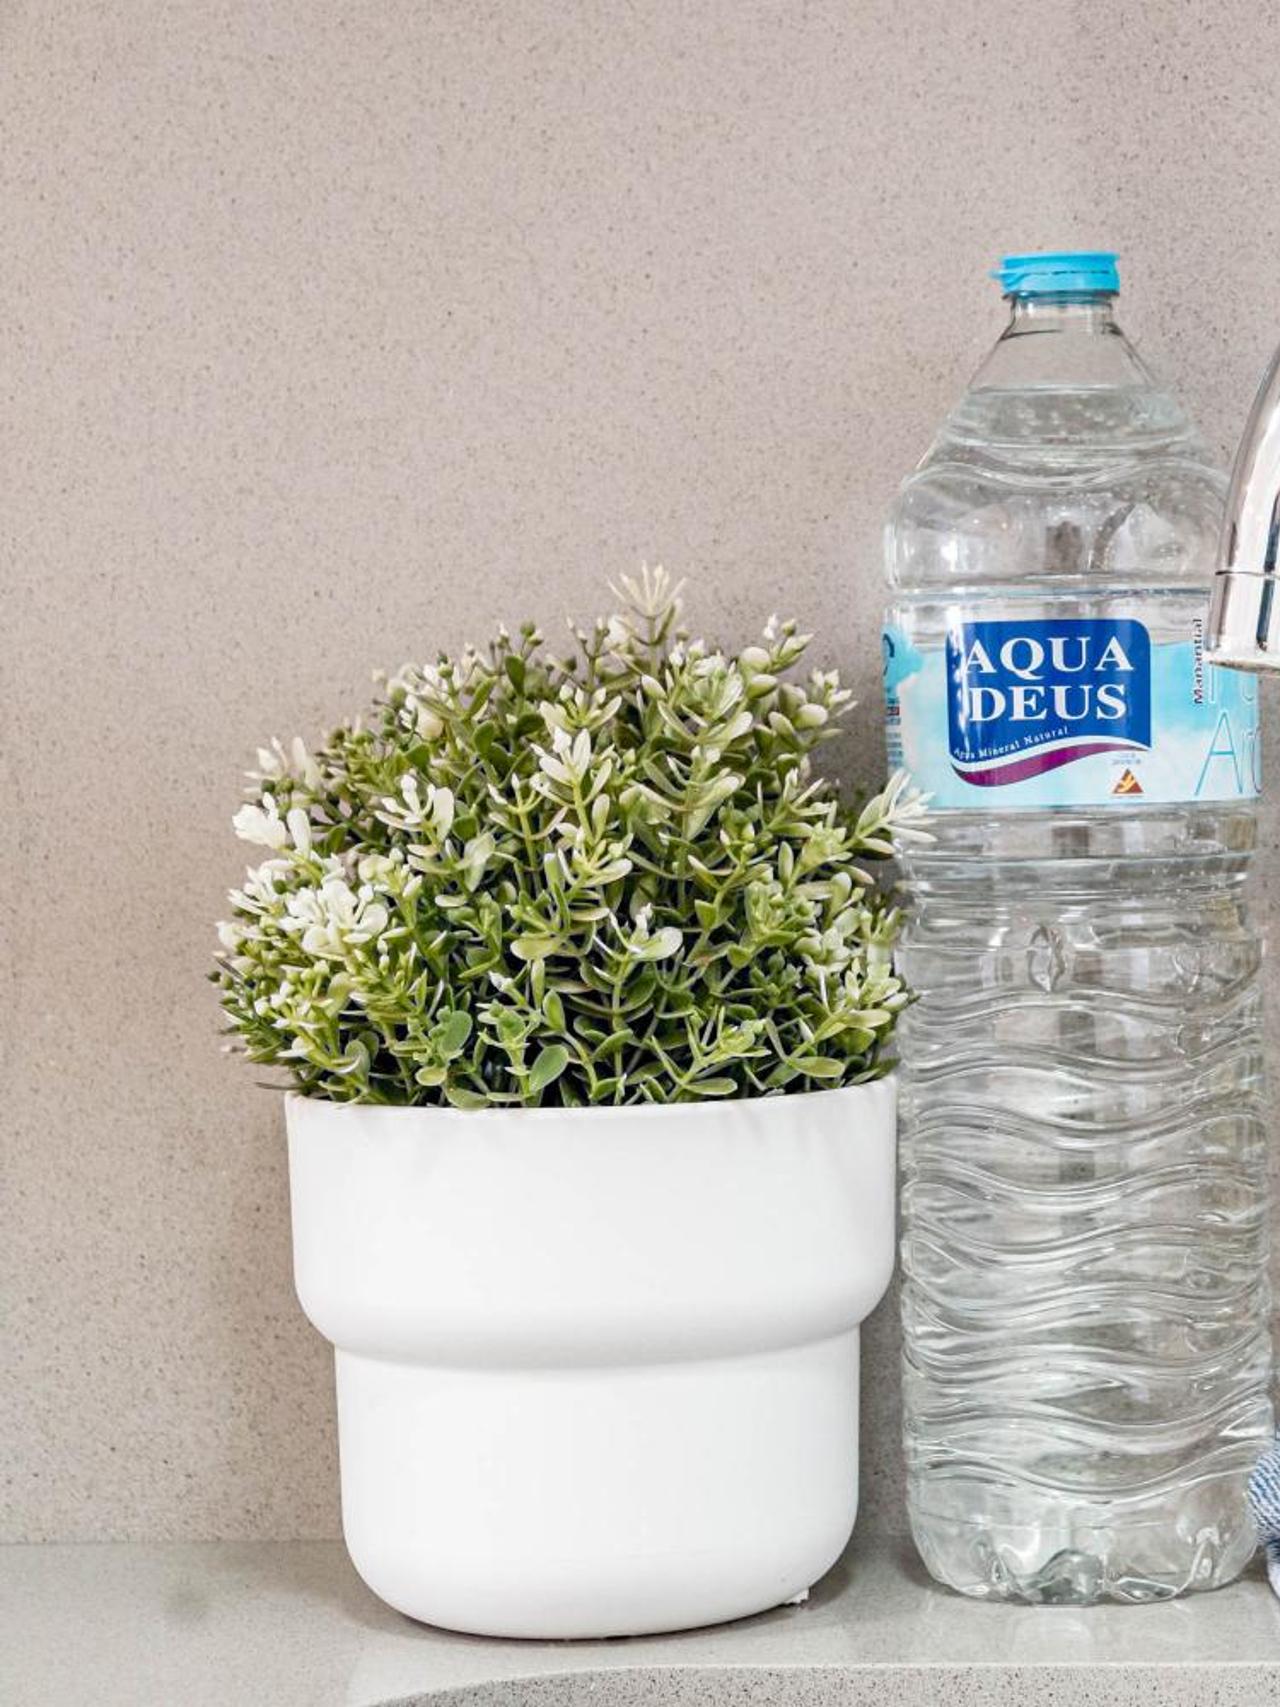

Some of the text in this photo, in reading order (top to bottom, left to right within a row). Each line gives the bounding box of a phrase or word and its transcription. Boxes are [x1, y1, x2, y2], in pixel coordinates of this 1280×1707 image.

[965, 636, 1134, 680] AQUA
[969, 684, 1127, 722] DEUS
[978, 739, 1020, 758] Mineral
[1023, 726, 1069, 747] Natural
